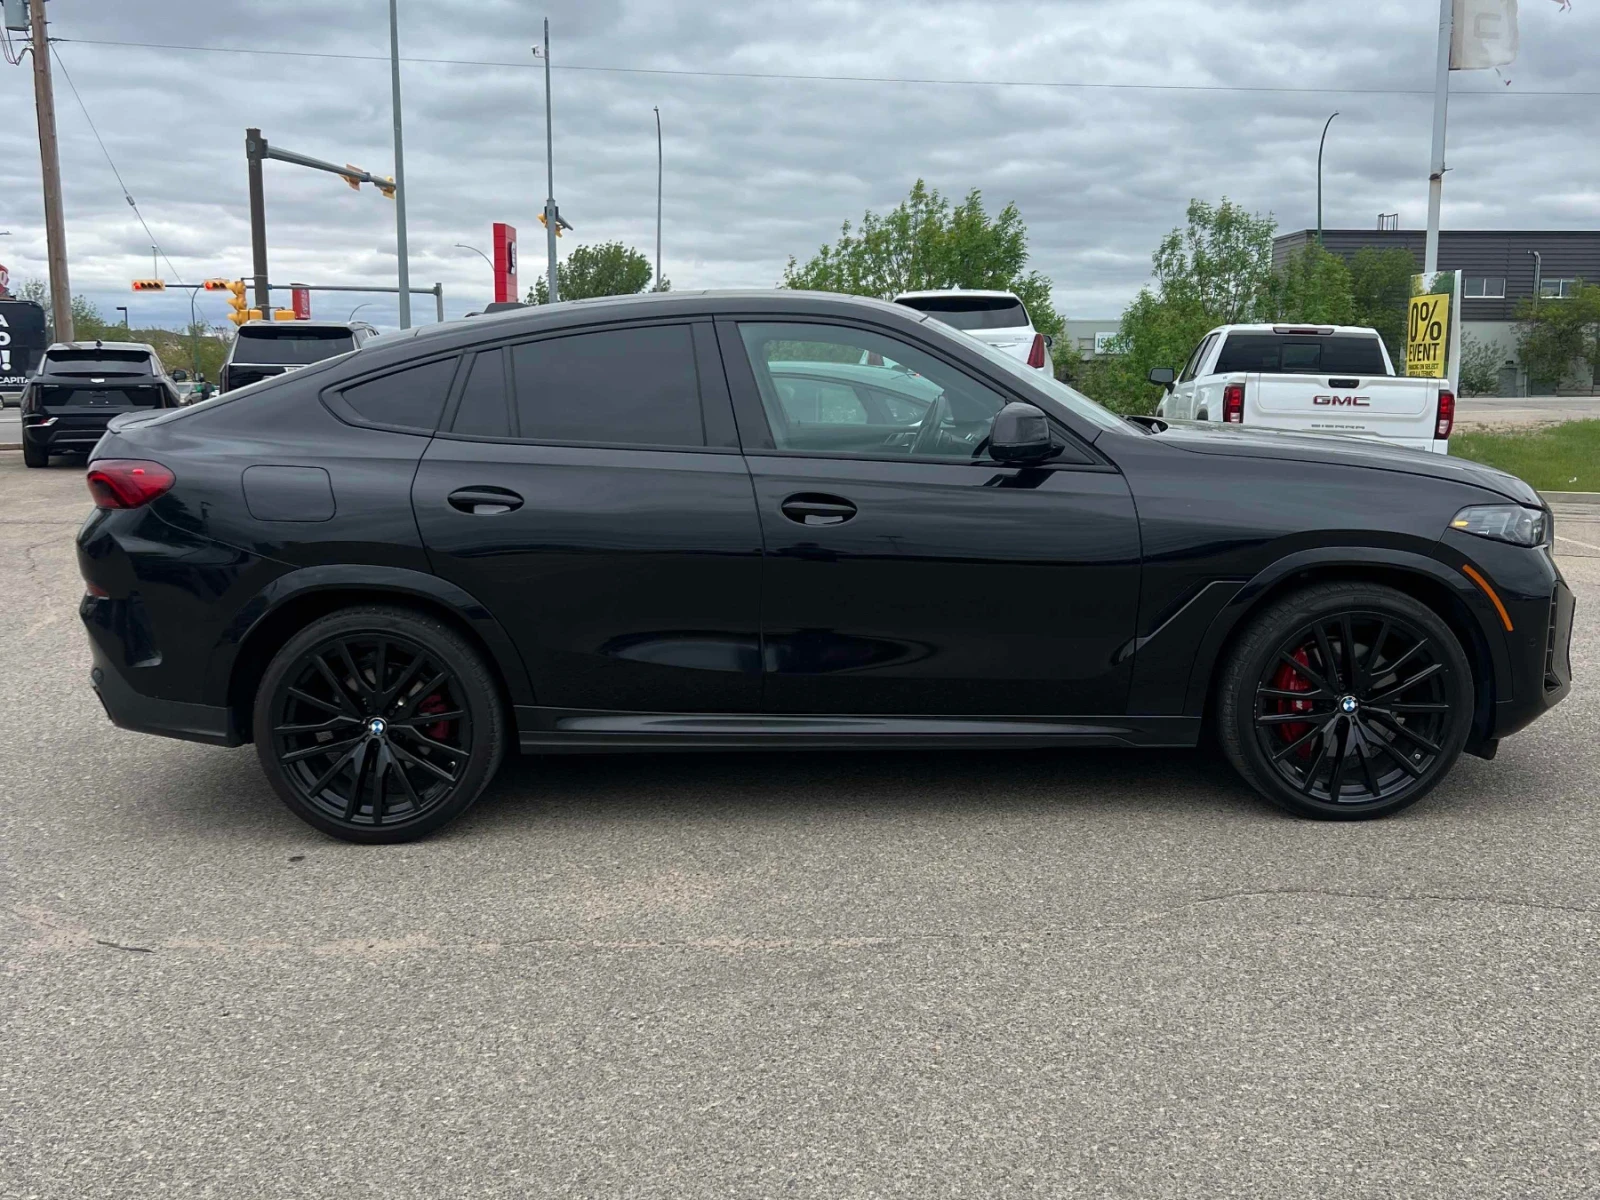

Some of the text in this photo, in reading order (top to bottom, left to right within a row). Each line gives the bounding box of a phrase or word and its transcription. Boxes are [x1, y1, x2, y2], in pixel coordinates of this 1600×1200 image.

[1410, 299, 1442, 342] 0%
[1408, 342, 1440, 362] EVENT
[1313, 395, 1371, 407] GMC
